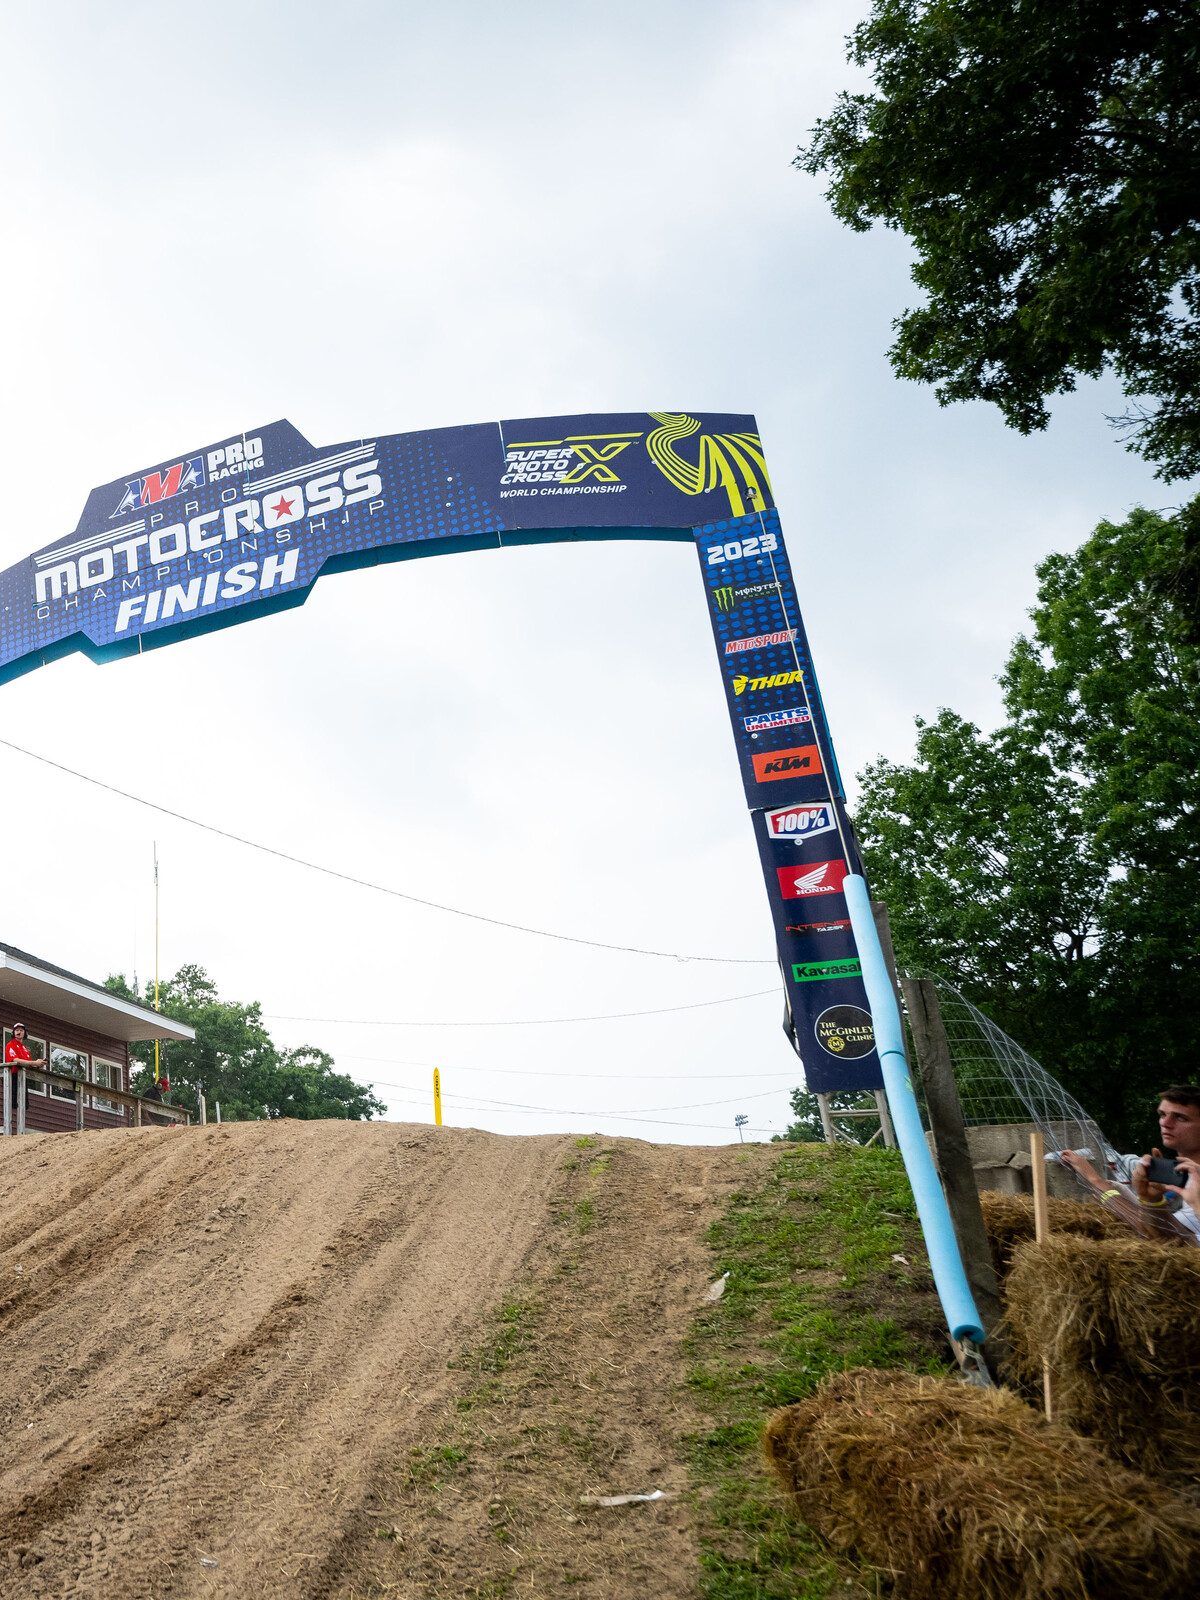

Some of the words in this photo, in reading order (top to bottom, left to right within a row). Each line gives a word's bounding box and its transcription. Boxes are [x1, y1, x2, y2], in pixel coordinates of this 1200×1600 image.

[506, 448, 574, 461] SUPER
[209, 457, 264, 483] RACING
[507, 460, 569, 473] MOTO
[109, 456, 205, 519] AMA
[207, 437, 263, 471] PRO
[500, 471, 568, 484] CROSS
[500, 489, 538, 498] WORLD
[540, 485, 627, 496] CHAMPIONSHIP
[151, 487, 237, 528] PRO
[35, 459, 383, 604] MOTOCROSS
[707, 533, 778, 565] 2023
[36, 499, 385, 620] CHAMPIONSHIP
[114, 548, 300, 633] FINISH
[735, 582, 782, 596] MONSTER
[749, 670, 804, 690] THOR
[746, 707, 809, 725] PARTS
[747, 715, 810, 731] UNLIMITED
[764, 755, 810, 774] KTM
[776, 809, 825, 832] 100%
[796, 885, 835, 895] HONDA
